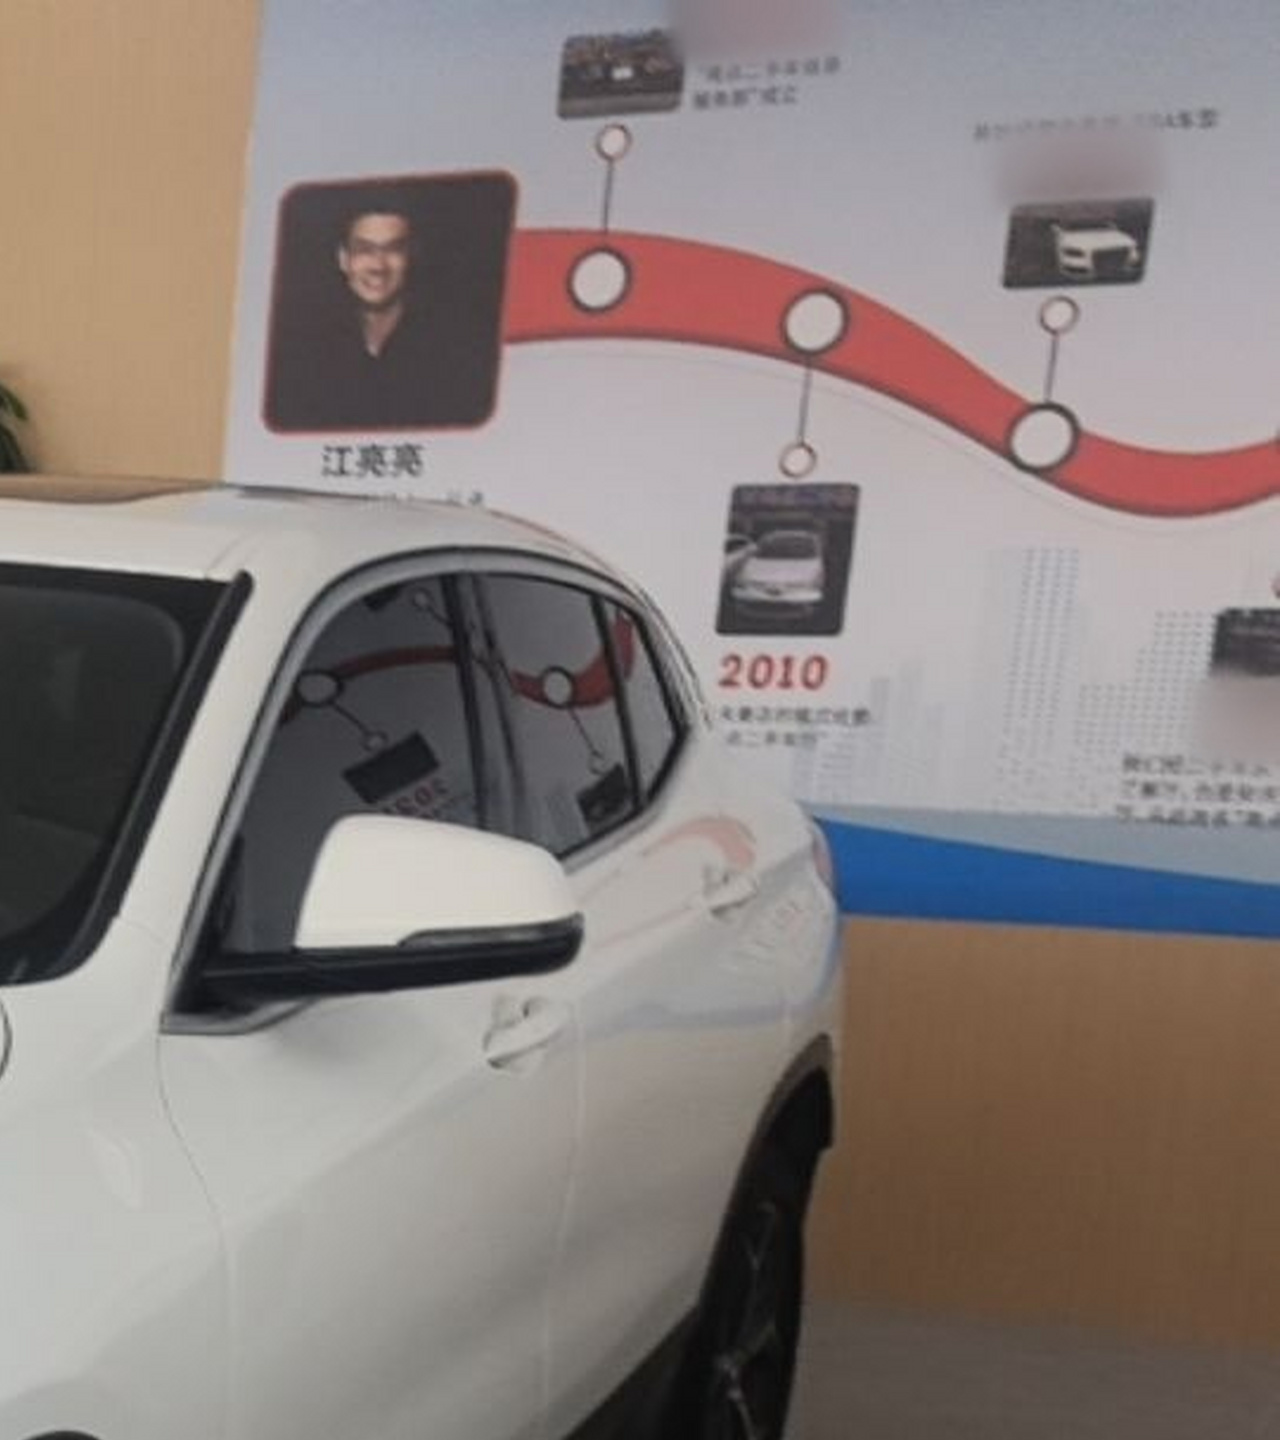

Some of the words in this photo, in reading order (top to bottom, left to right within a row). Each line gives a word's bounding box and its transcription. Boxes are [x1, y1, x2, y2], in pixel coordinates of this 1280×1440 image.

[321, 442, 425, 477] 江亮亮
[718, 653, 831, 691] 2010
